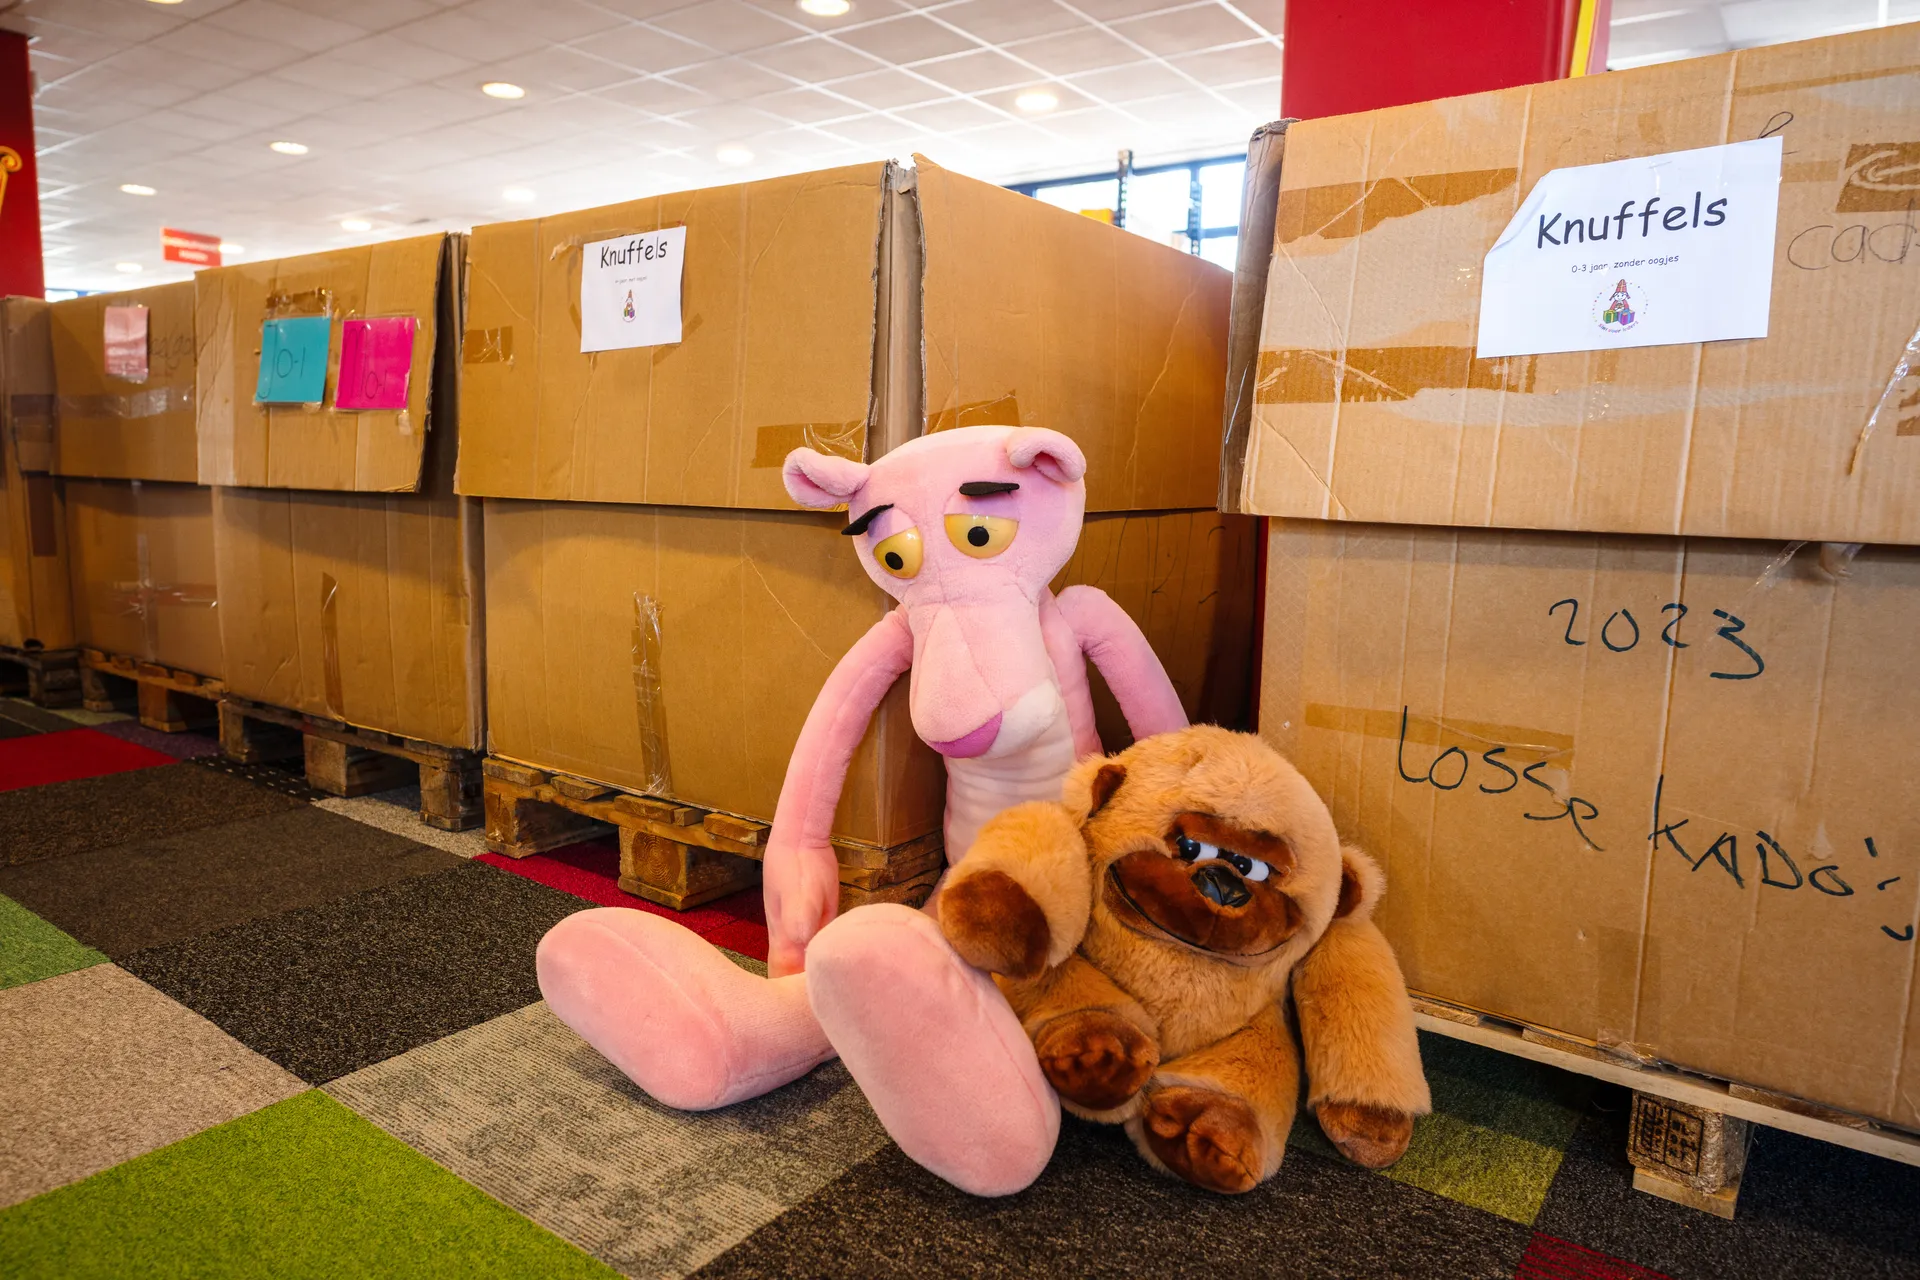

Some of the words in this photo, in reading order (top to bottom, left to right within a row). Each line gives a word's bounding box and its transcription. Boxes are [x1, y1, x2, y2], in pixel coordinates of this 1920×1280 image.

[1537, 191, 1727, 248] Knuffels
[600, 236, 668, 269] Knuffels
[1571, 264, 1587, 273] 0-3
[1613, 258, 1646, 269] zonder
[1647, 255, 1679, 266] oogjes
[1547, 597, 1766, 681] 2023
